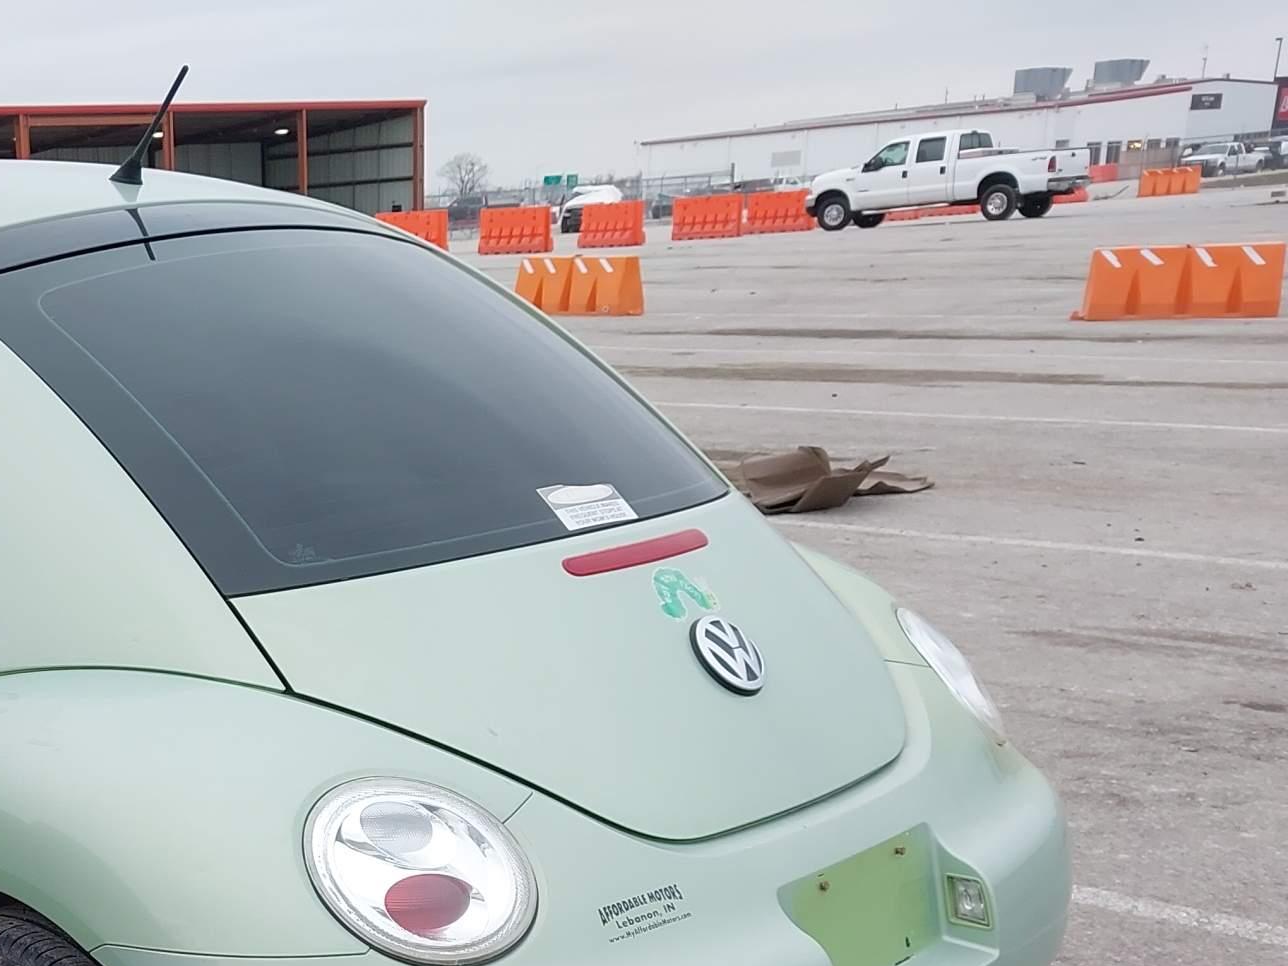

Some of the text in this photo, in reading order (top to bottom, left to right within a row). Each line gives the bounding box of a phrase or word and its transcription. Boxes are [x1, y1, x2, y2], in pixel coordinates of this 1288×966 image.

[597, 883, 683, 926] AFFORDABLE MOTORS
[615, 902, 676, 929] Lebanon, IN
